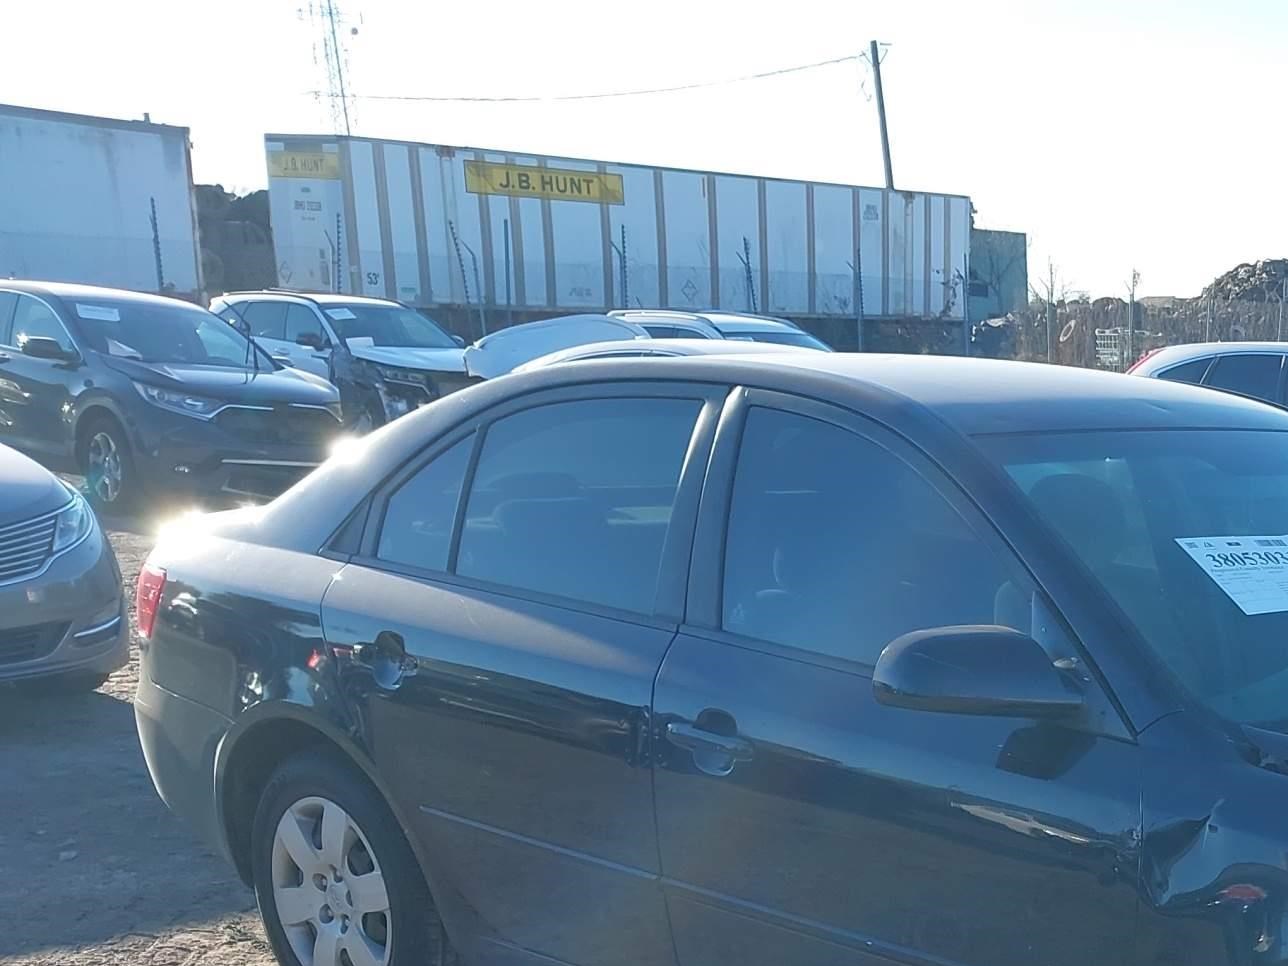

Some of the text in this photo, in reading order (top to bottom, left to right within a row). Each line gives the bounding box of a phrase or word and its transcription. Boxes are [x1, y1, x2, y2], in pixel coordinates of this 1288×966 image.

[301, 158, 325, 172] HUNT
[499, 171, 594, 195] J.B. HUNT
